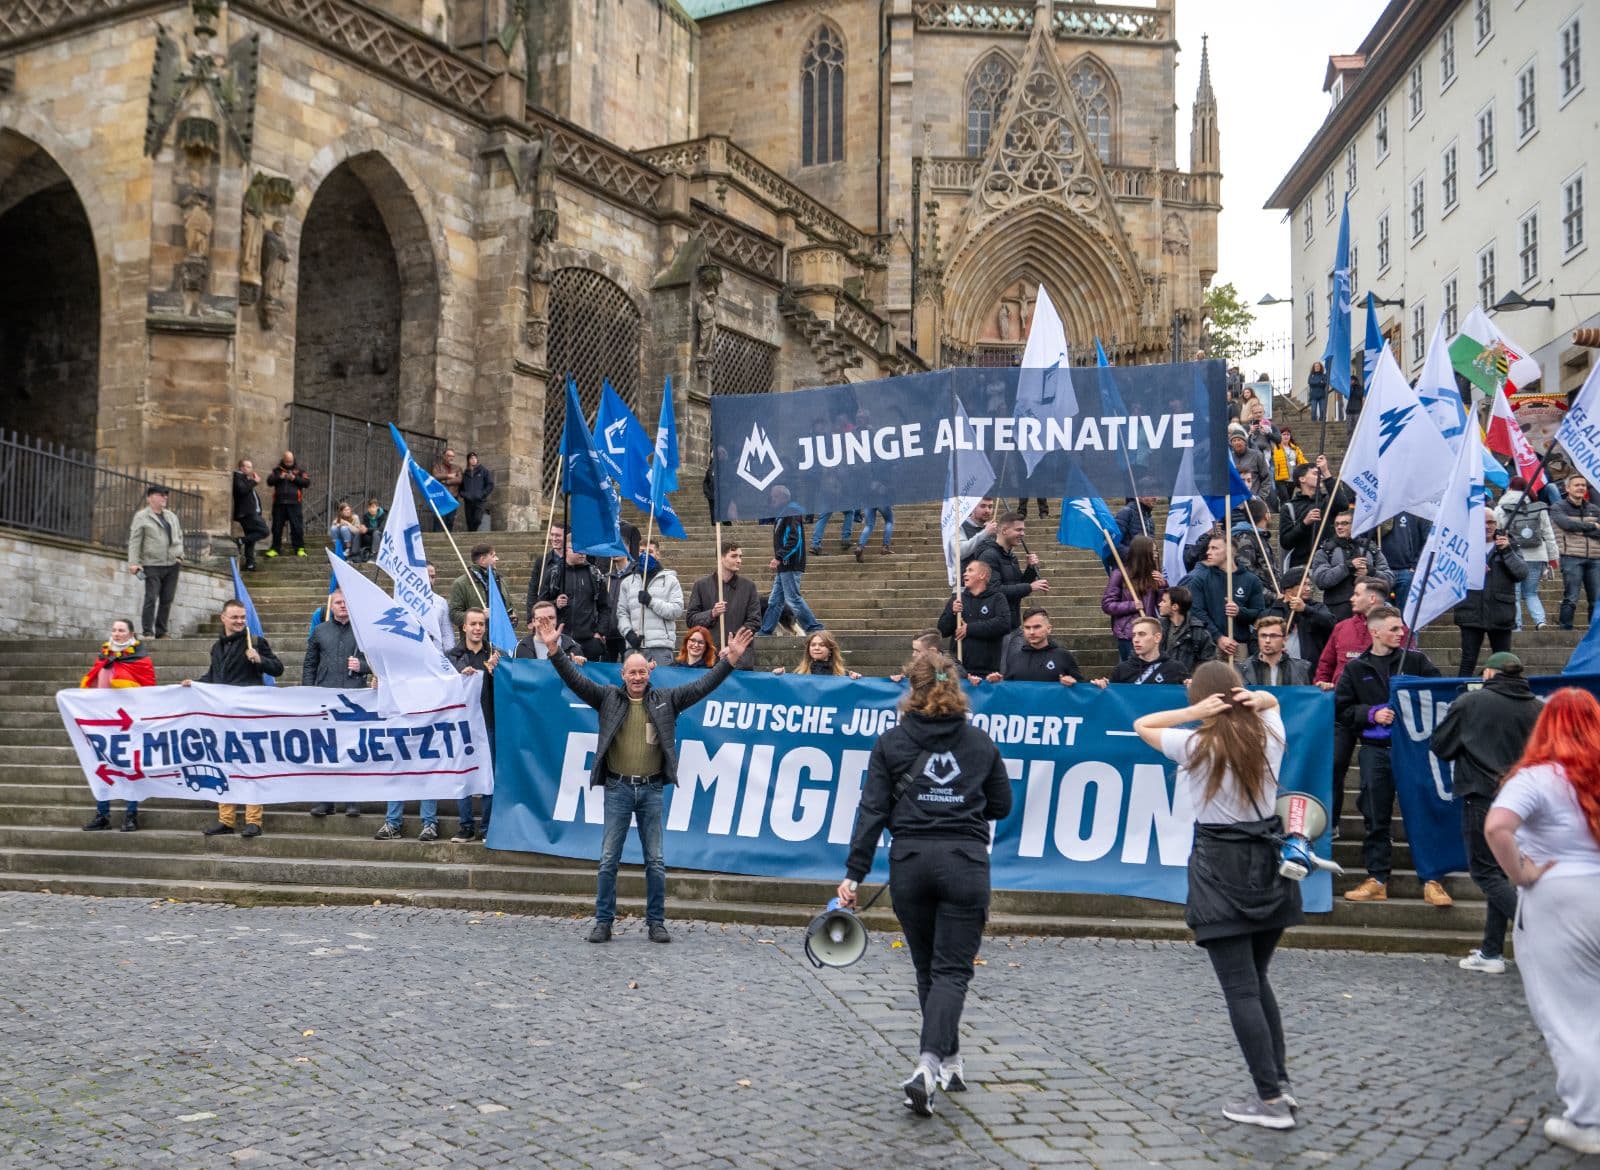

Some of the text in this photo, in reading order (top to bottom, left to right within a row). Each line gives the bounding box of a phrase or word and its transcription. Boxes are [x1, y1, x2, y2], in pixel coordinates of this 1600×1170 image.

[798, 412, 1195, 471] JUNGE ALTERNATIVE
[142, 727, 339, 767] MIGRATION
[346, 720, 475, 762] JETZT!
[702, 700, 1084, 746] DEUTSCHE JUG ORDERT
[917, 793, 965, 803] ALTERNATIVE
